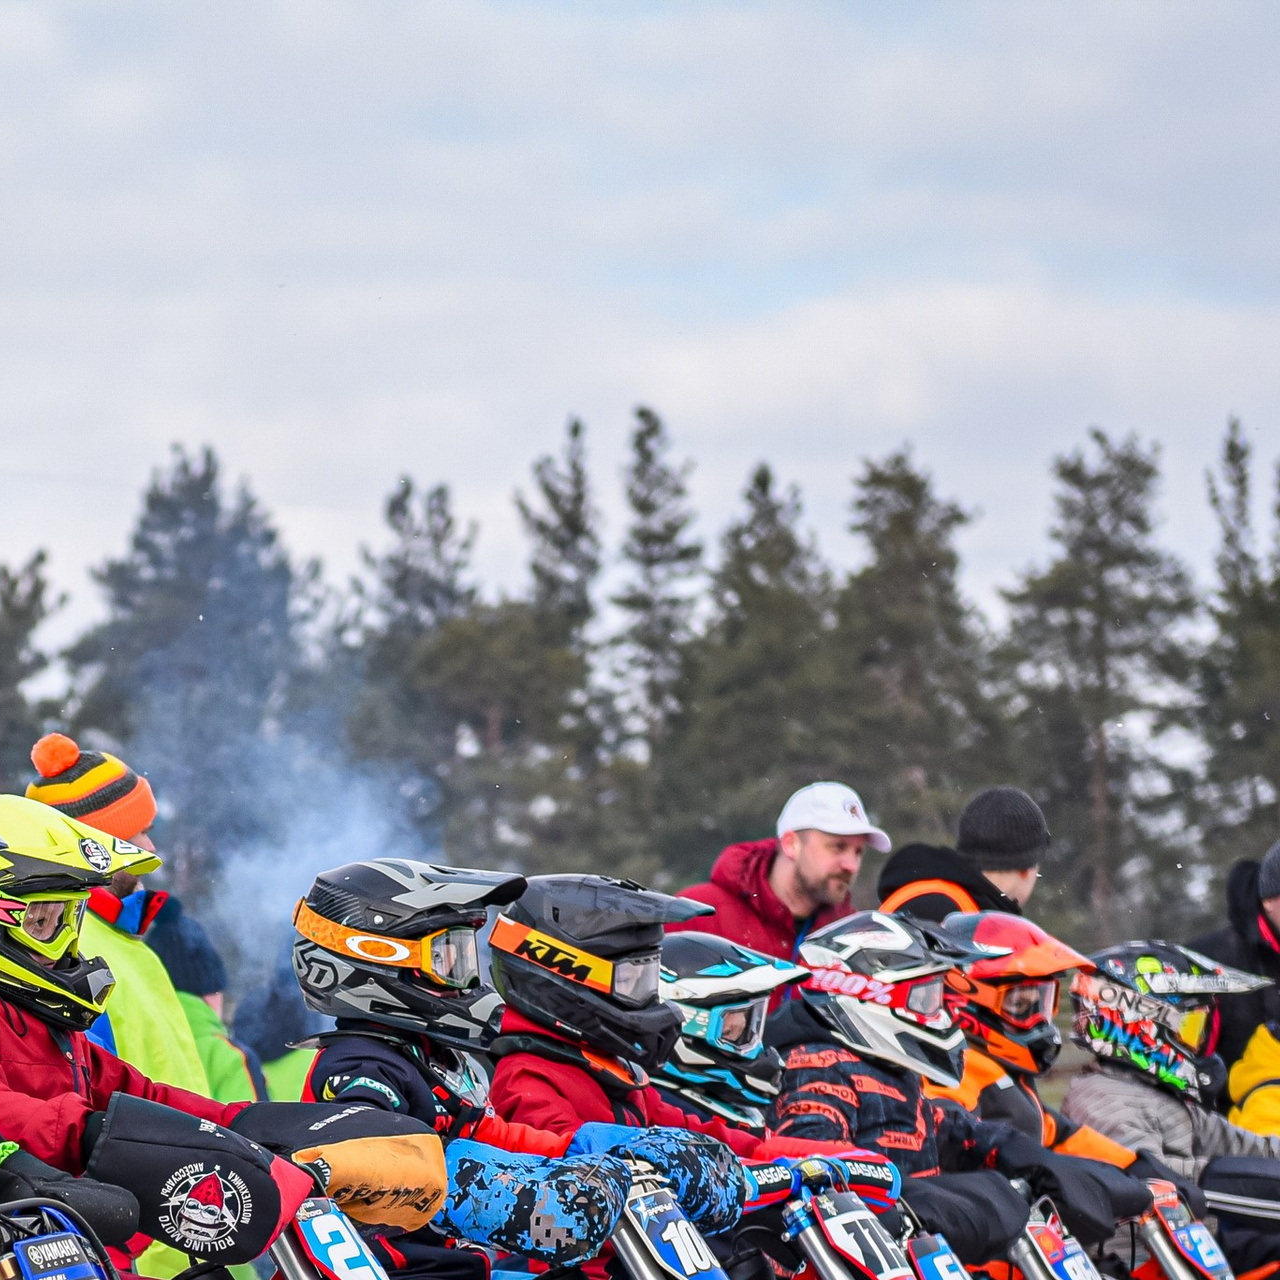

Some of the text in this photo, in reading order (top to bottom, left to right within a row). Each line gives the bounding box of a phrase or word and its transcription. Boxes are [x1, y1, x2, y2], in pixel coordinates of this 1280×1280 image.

[515, 938, 593, 984] KTM
[752, 1165, 791, 1185] GASGAS
[848, 1161, 894, 1182] GASGAS
[158, 1214, 235, 1253] ROLLING MOTO
[38, 1238, 80, 1262] YAMAHA
[39, 1256, 80, 1270] RACING
